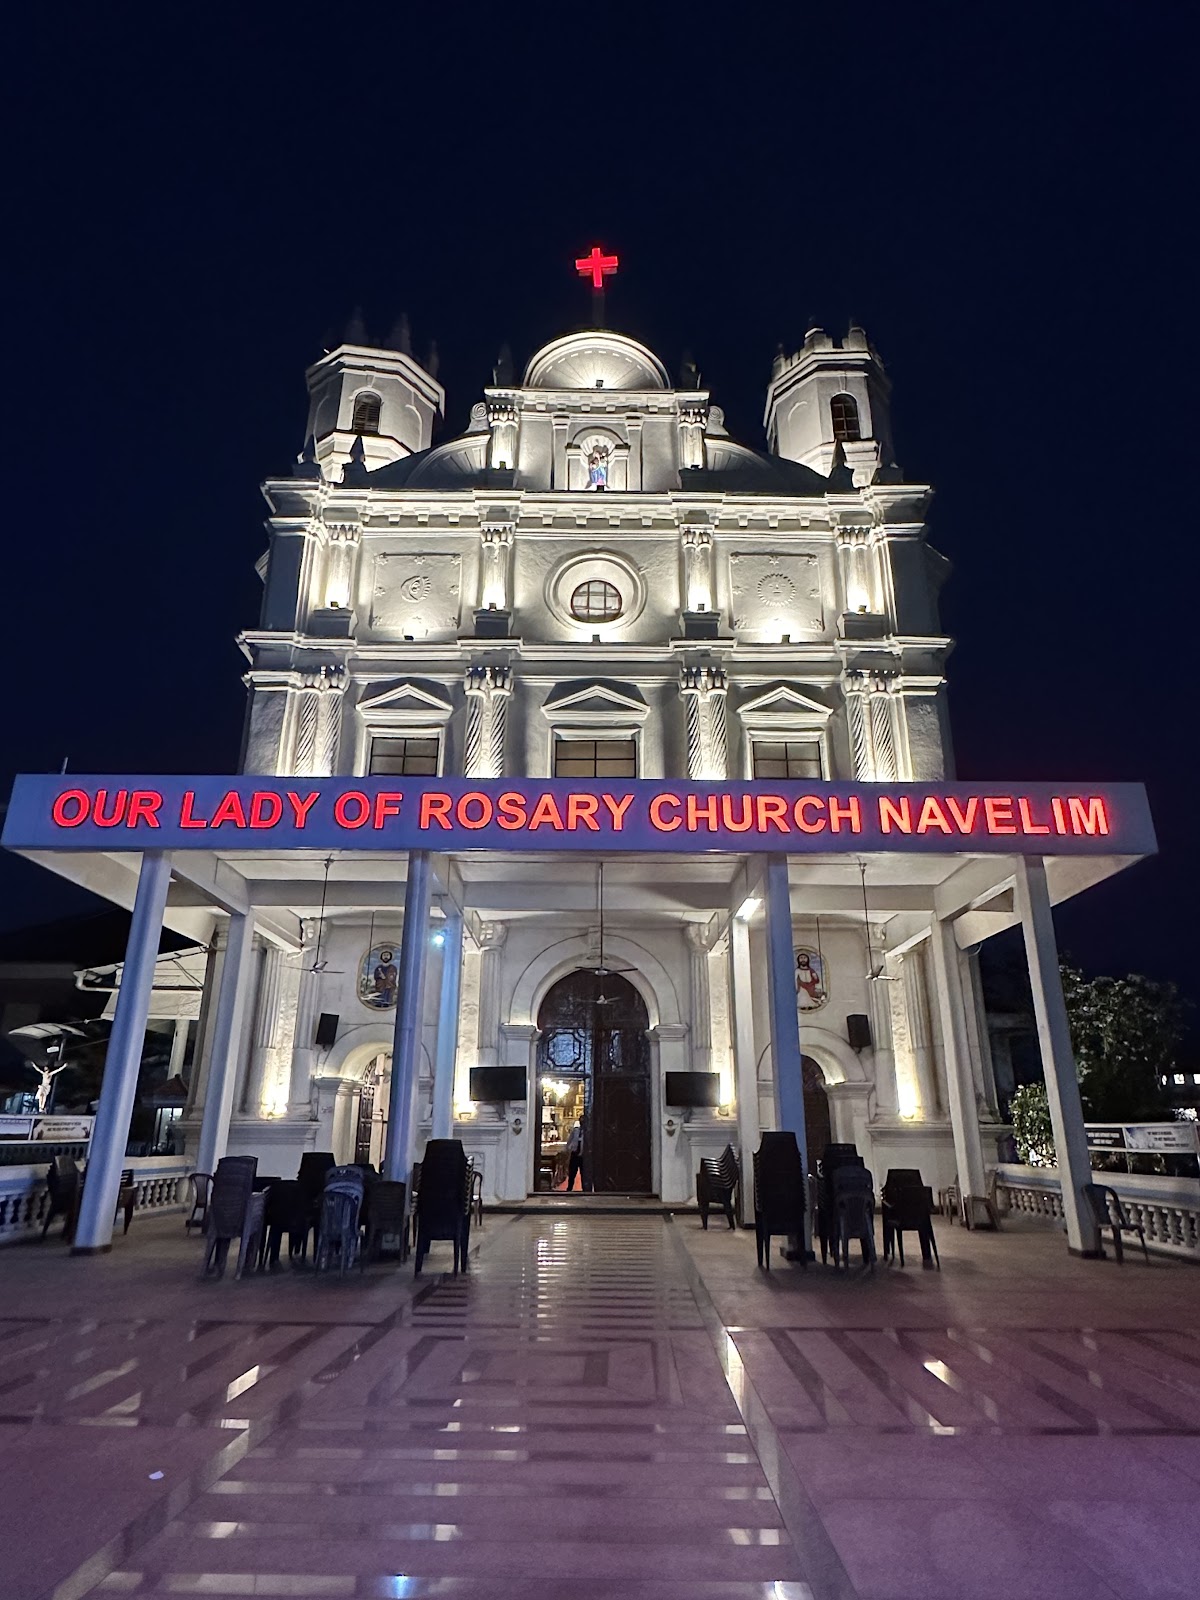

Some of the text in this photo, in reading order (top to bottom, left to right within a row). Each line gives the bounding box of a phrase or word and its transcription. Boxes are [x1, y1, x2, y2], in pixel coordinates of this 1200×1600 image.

[52, 788, 1111, 837] OUR LADY OF ROSARY CHURCH NAVELIM
